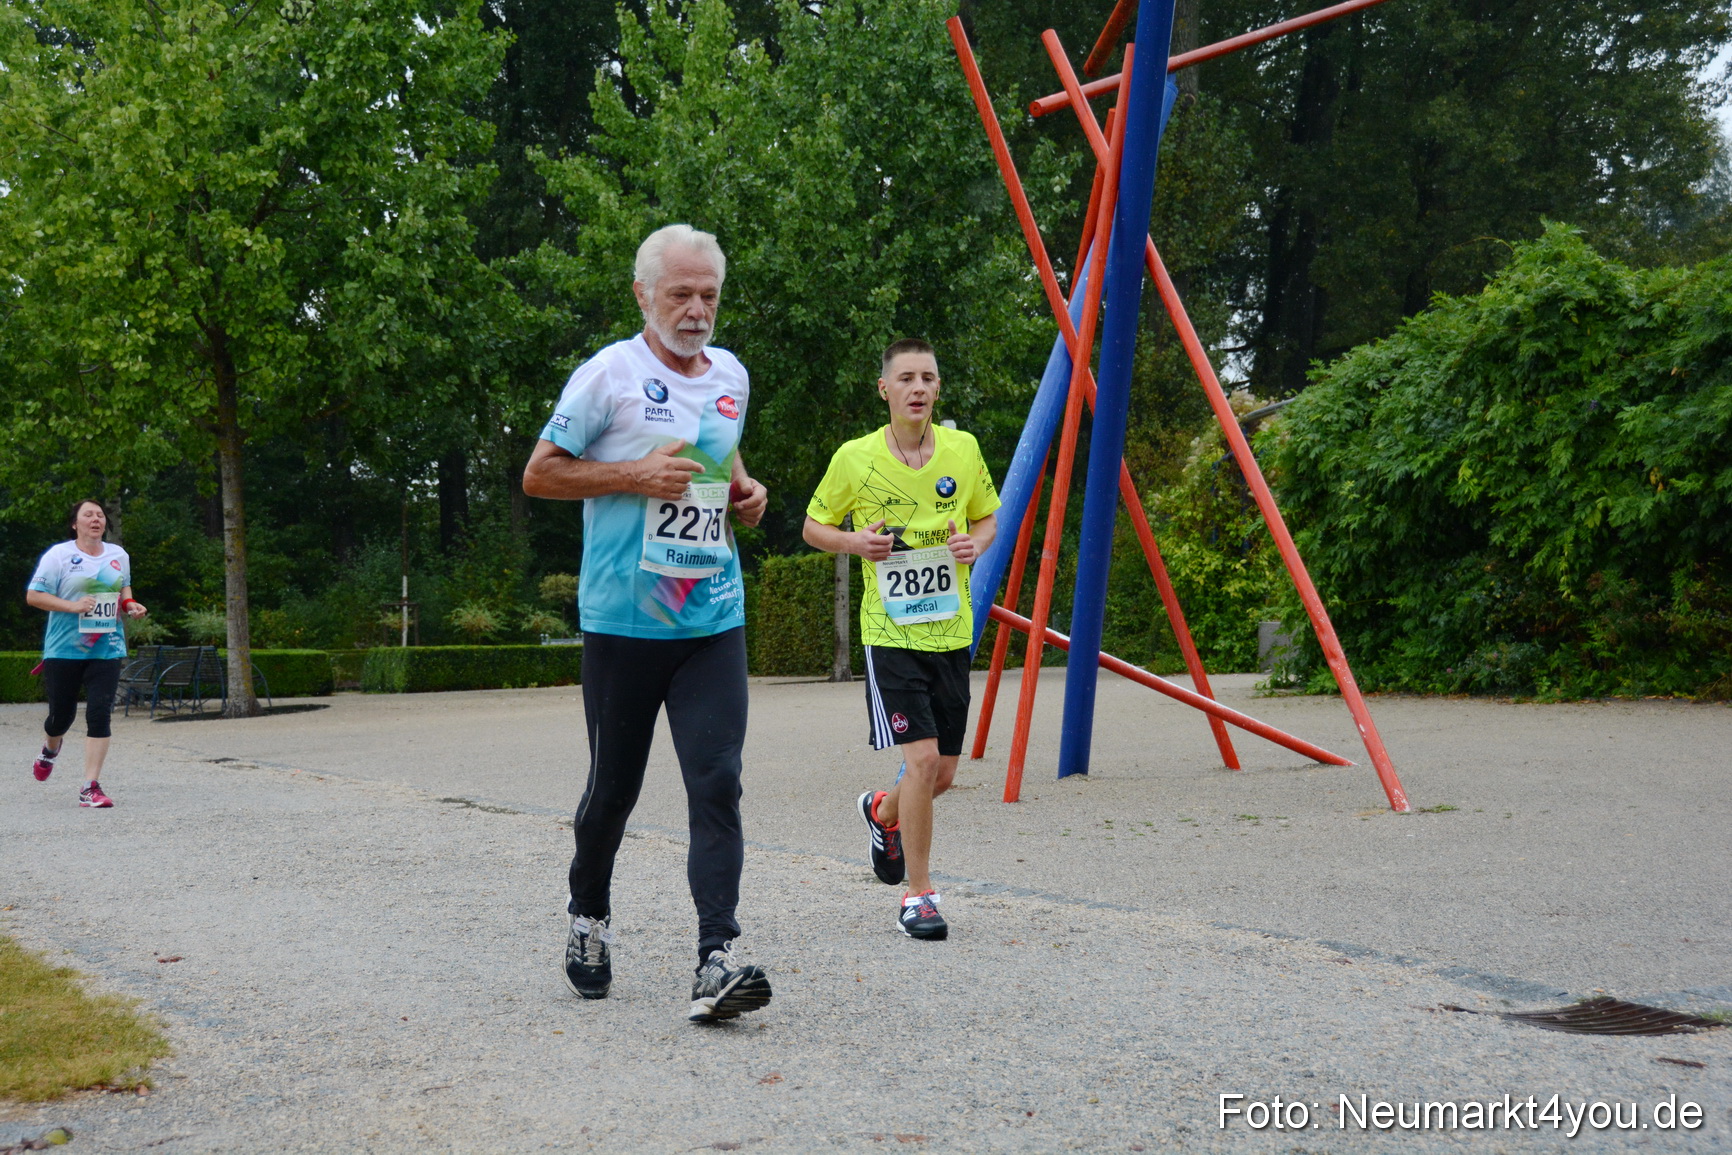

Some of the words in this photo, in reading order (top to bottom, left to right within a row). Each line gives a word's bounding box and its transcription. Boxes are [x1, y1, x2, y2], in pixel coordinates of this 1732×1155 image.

[645, 407, 675, 418] PARTL
[645, 415, 676, 423] Neumarkt
[656, 502, 724, 542] 2275
[913, 530, 930, 539] THE
[921, 537, 935, 546] 100
[912, 550, 949, 562] BOCK
[886, 565, 952, 597] 2826
[905, 600, 939, 614] Pascal
